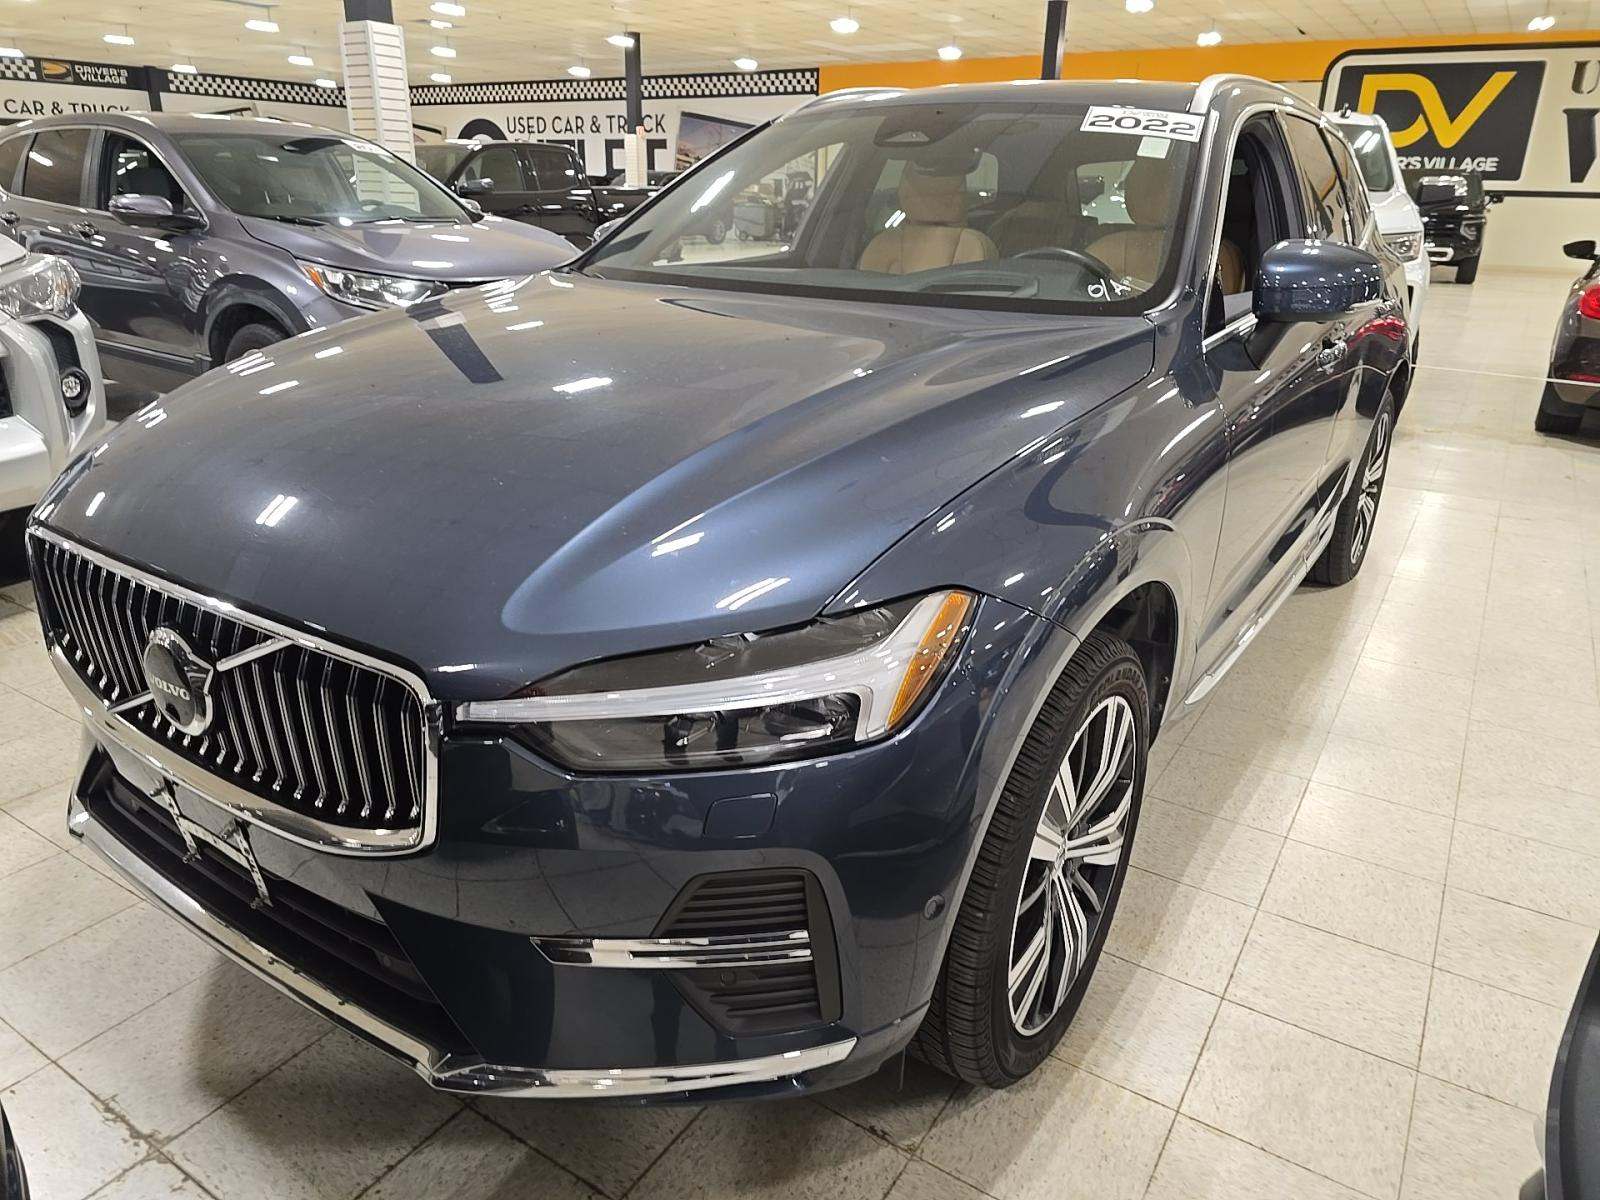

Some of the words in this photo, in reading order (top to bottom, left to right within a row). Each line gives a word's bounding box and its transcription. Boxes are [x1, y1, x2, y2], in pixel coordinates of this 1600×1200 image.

[75, 64, 128, 77] DRIVER'S
[80, 72, 127, 84] VILLAGE
[4, 99, 45, 116] CAR
[51, 101, 63, 115] &
[506, 116, 547, 134] USED
[552, 115, 584, 134] CAR
[590, 115, 601, 133] &
[606, 113, 666, 134] TRCK
[1088, 114, 1196, 136] 2022
[1423, 156, 1499, 173] VILLAGE
[151, 674, 190, 701] VOLVO
